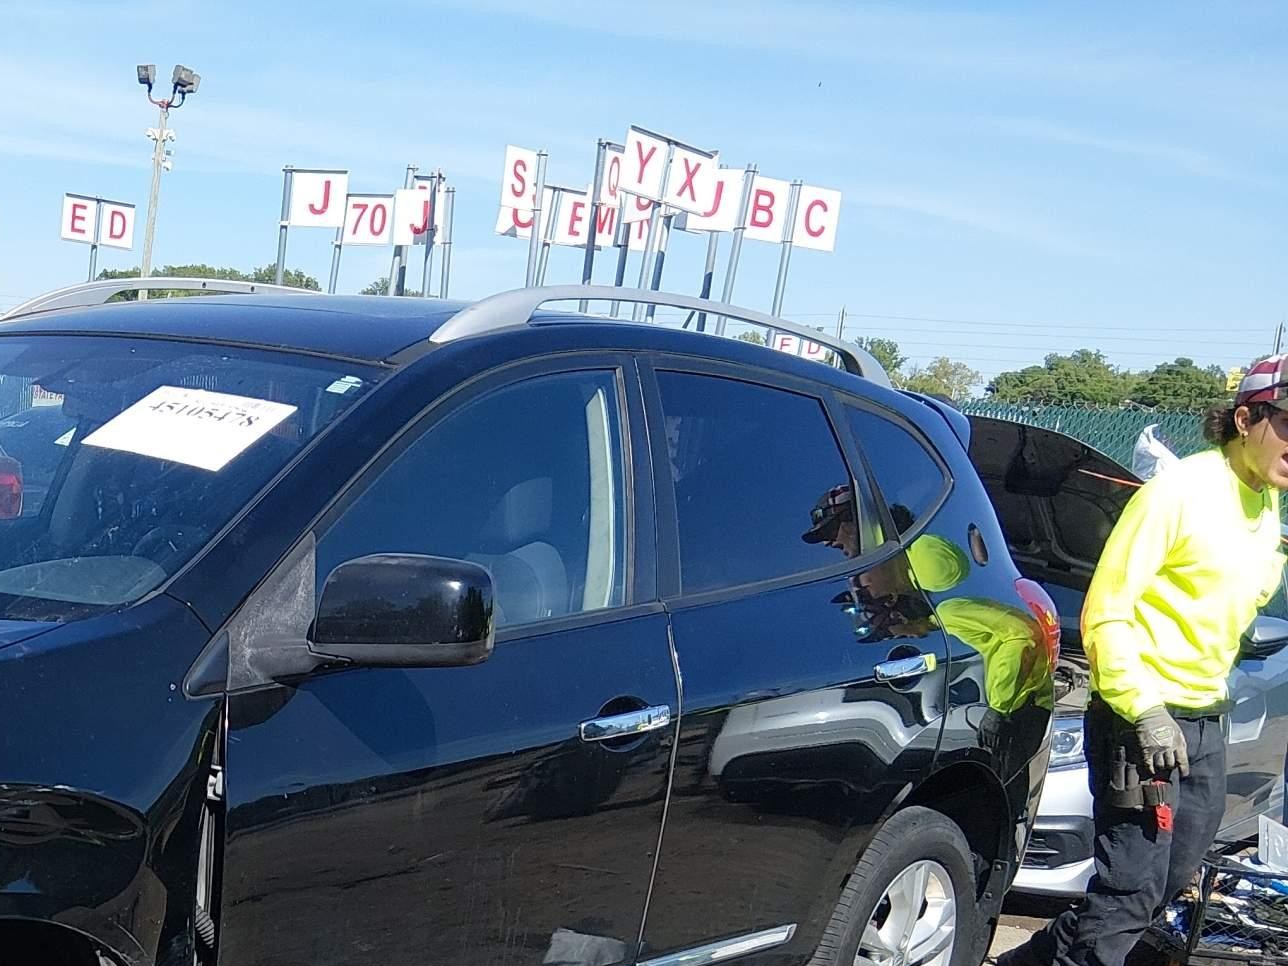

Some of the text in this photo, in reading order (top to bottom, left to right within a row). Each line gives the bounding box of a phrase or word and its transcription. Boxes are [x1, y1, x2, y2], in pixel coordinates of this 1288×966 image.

[511, 159, 527, 198] S
[636, 141, 656, 184] Y
[676, 157, 702, 202] X
[308, 180, 331, 215] J
[704, 180, 725, 218] J
[749, 189, 776, 228] B
[71, 203, 87, 234] E
[109, 210, 127, 240] D
[352, 203, 387, 237] 70
[410, 200, 430, 235] J
[568, 201, 585, 236] E
[804, 199, 829, 238] C
